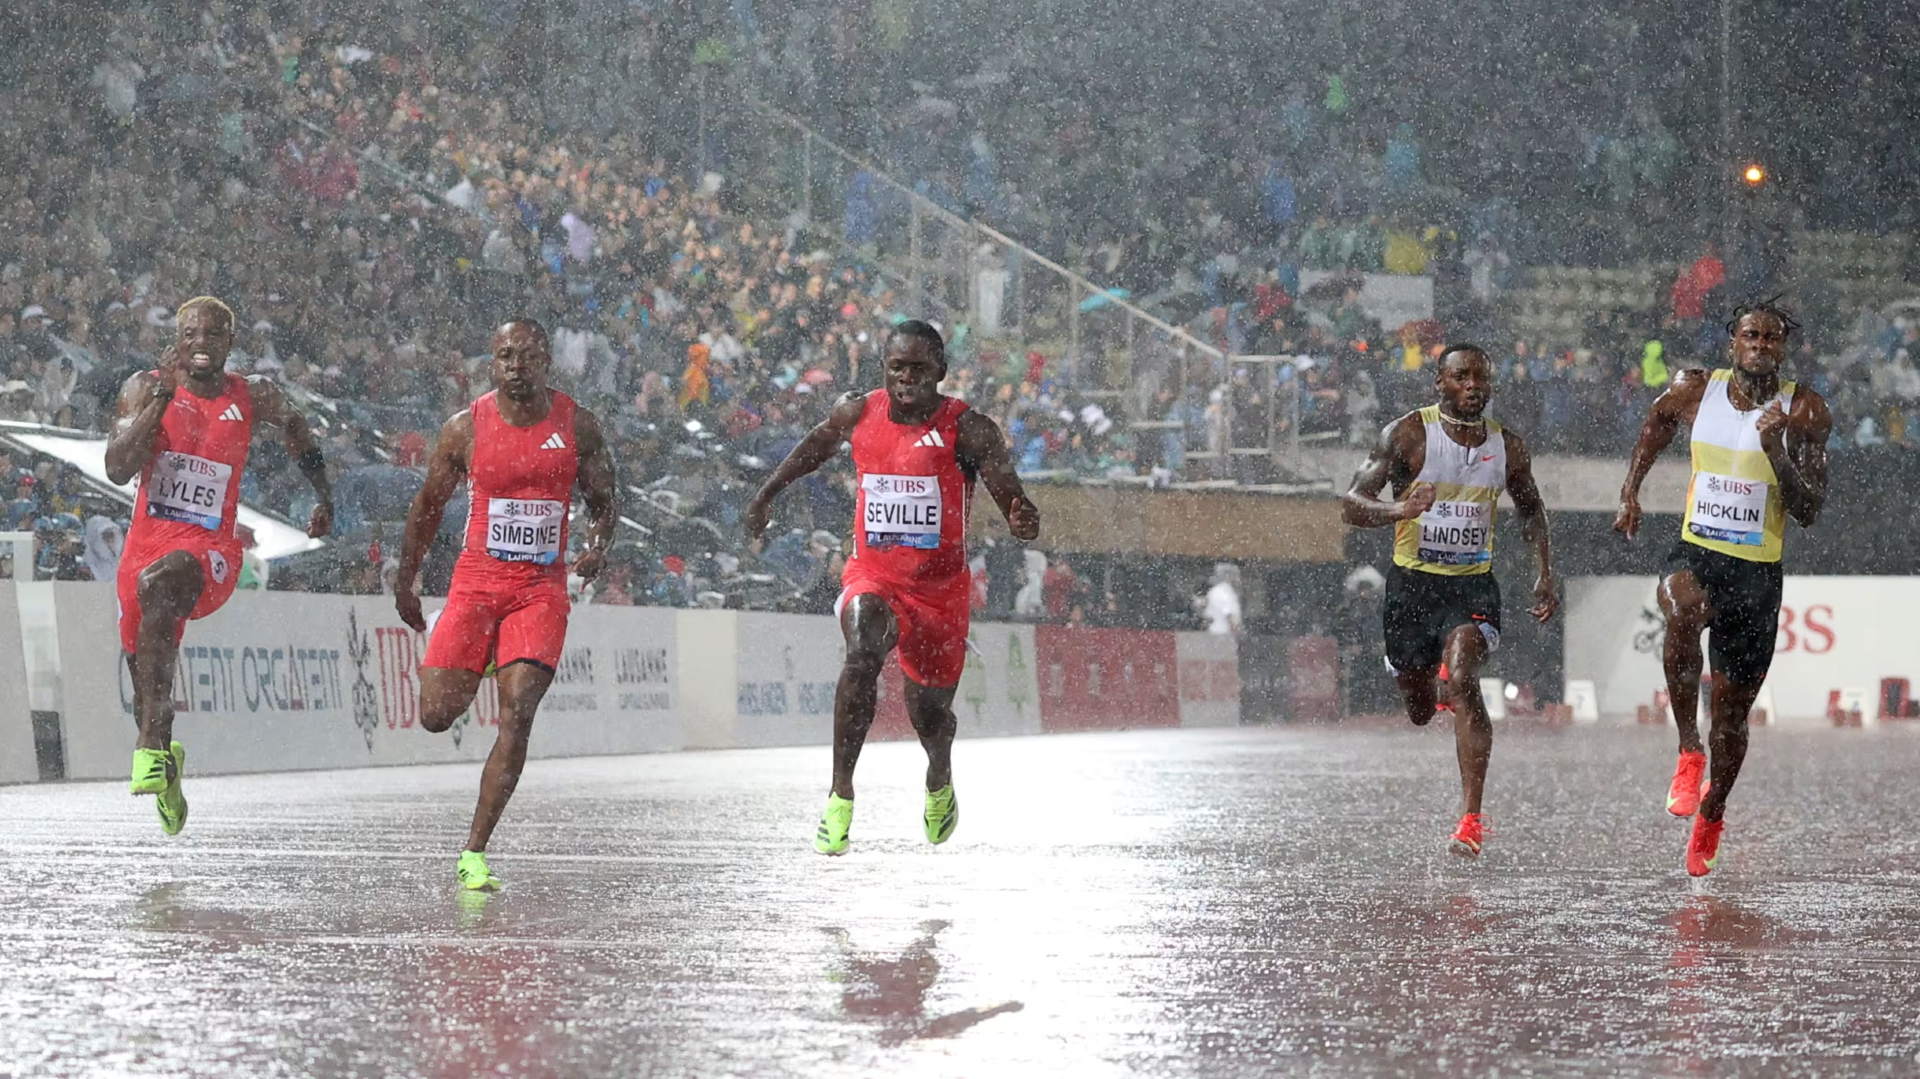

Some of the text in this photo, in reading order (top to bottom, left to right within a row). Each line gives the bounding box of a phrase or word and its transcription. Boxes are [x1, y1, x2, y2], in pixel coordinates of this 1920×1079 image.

[189, 459, 217, 477] UBS
[158, 477, 216, 508] LYLES
[893, 479, 926, 494] UBS
[1723, 480, 1752, 496] UBS
[523, 503, 553, 517] UBS
[867, 502, 937, 526] SEVILLE
[1454, 505, 1482, 518] UBS
[1697, 500, 1759, 522] HICKLIN
[491, 523, 557, 546] SIMBINE
[1423, 524, 1487, 546] LINDSEY
[1774, 604, 1836, 655] BS
